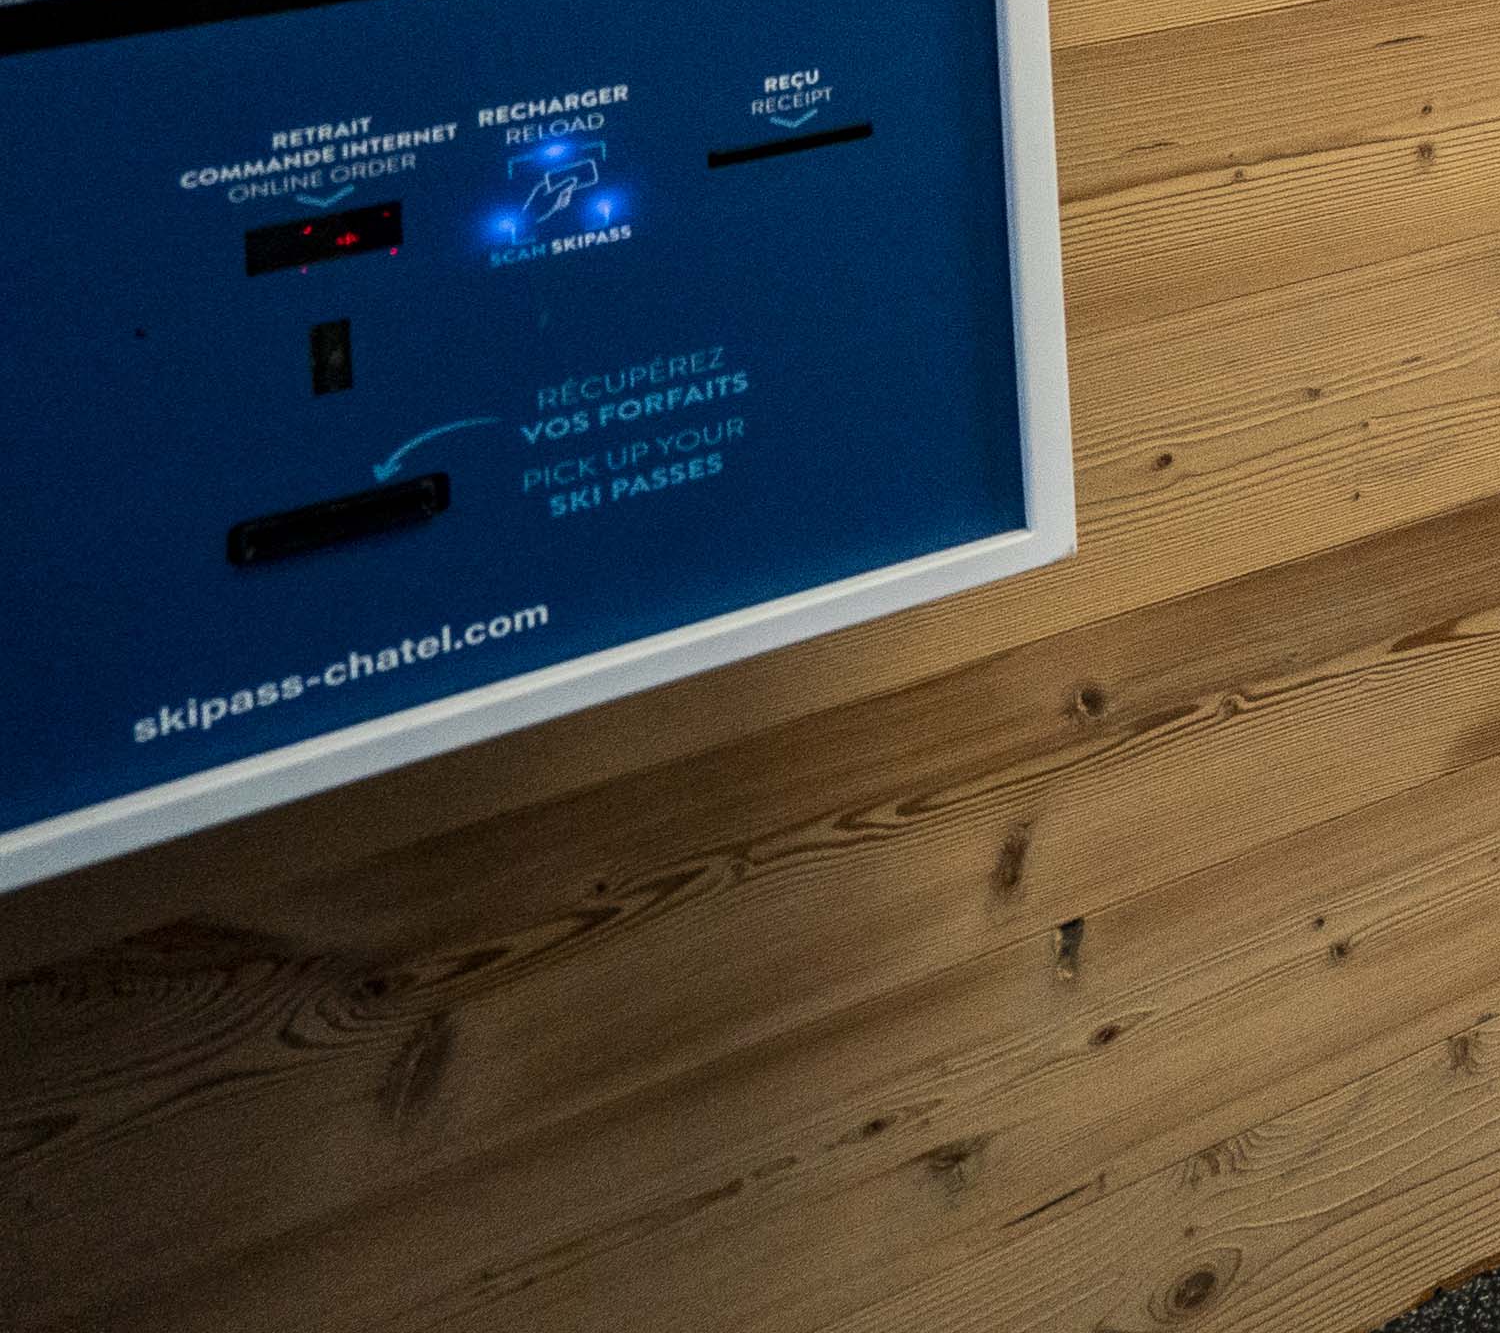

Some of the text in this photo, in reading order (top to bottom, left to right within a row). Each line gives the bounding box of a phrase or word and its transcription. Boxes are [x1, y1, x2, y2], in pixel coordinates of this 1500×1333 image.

[478, 83, 629, 128] RECHARGER
[751, 86, 833, 117] RECEIPT
[764, 69, 820, 94] REÇU
[271, 116, 373, 151] RETRAIT
[505, 112, 606, 145] RELOAD
[180, 123, 458, 190] COMMANDE INTERNET
[228, 152, 417, 204] ONLINE ORDER
[551, 224, 633, 255] SKIPASS
[537, 344, 726, 411] RÉCUPÉREZ
[521, 371, 749, 445] VOS FORFAITS
[524, 416, 746, 494] PICK UP YOUR
[550, 452, 725, 520] SKI PASSES
[133, 599, 550, 744] skipass-chatel.com
